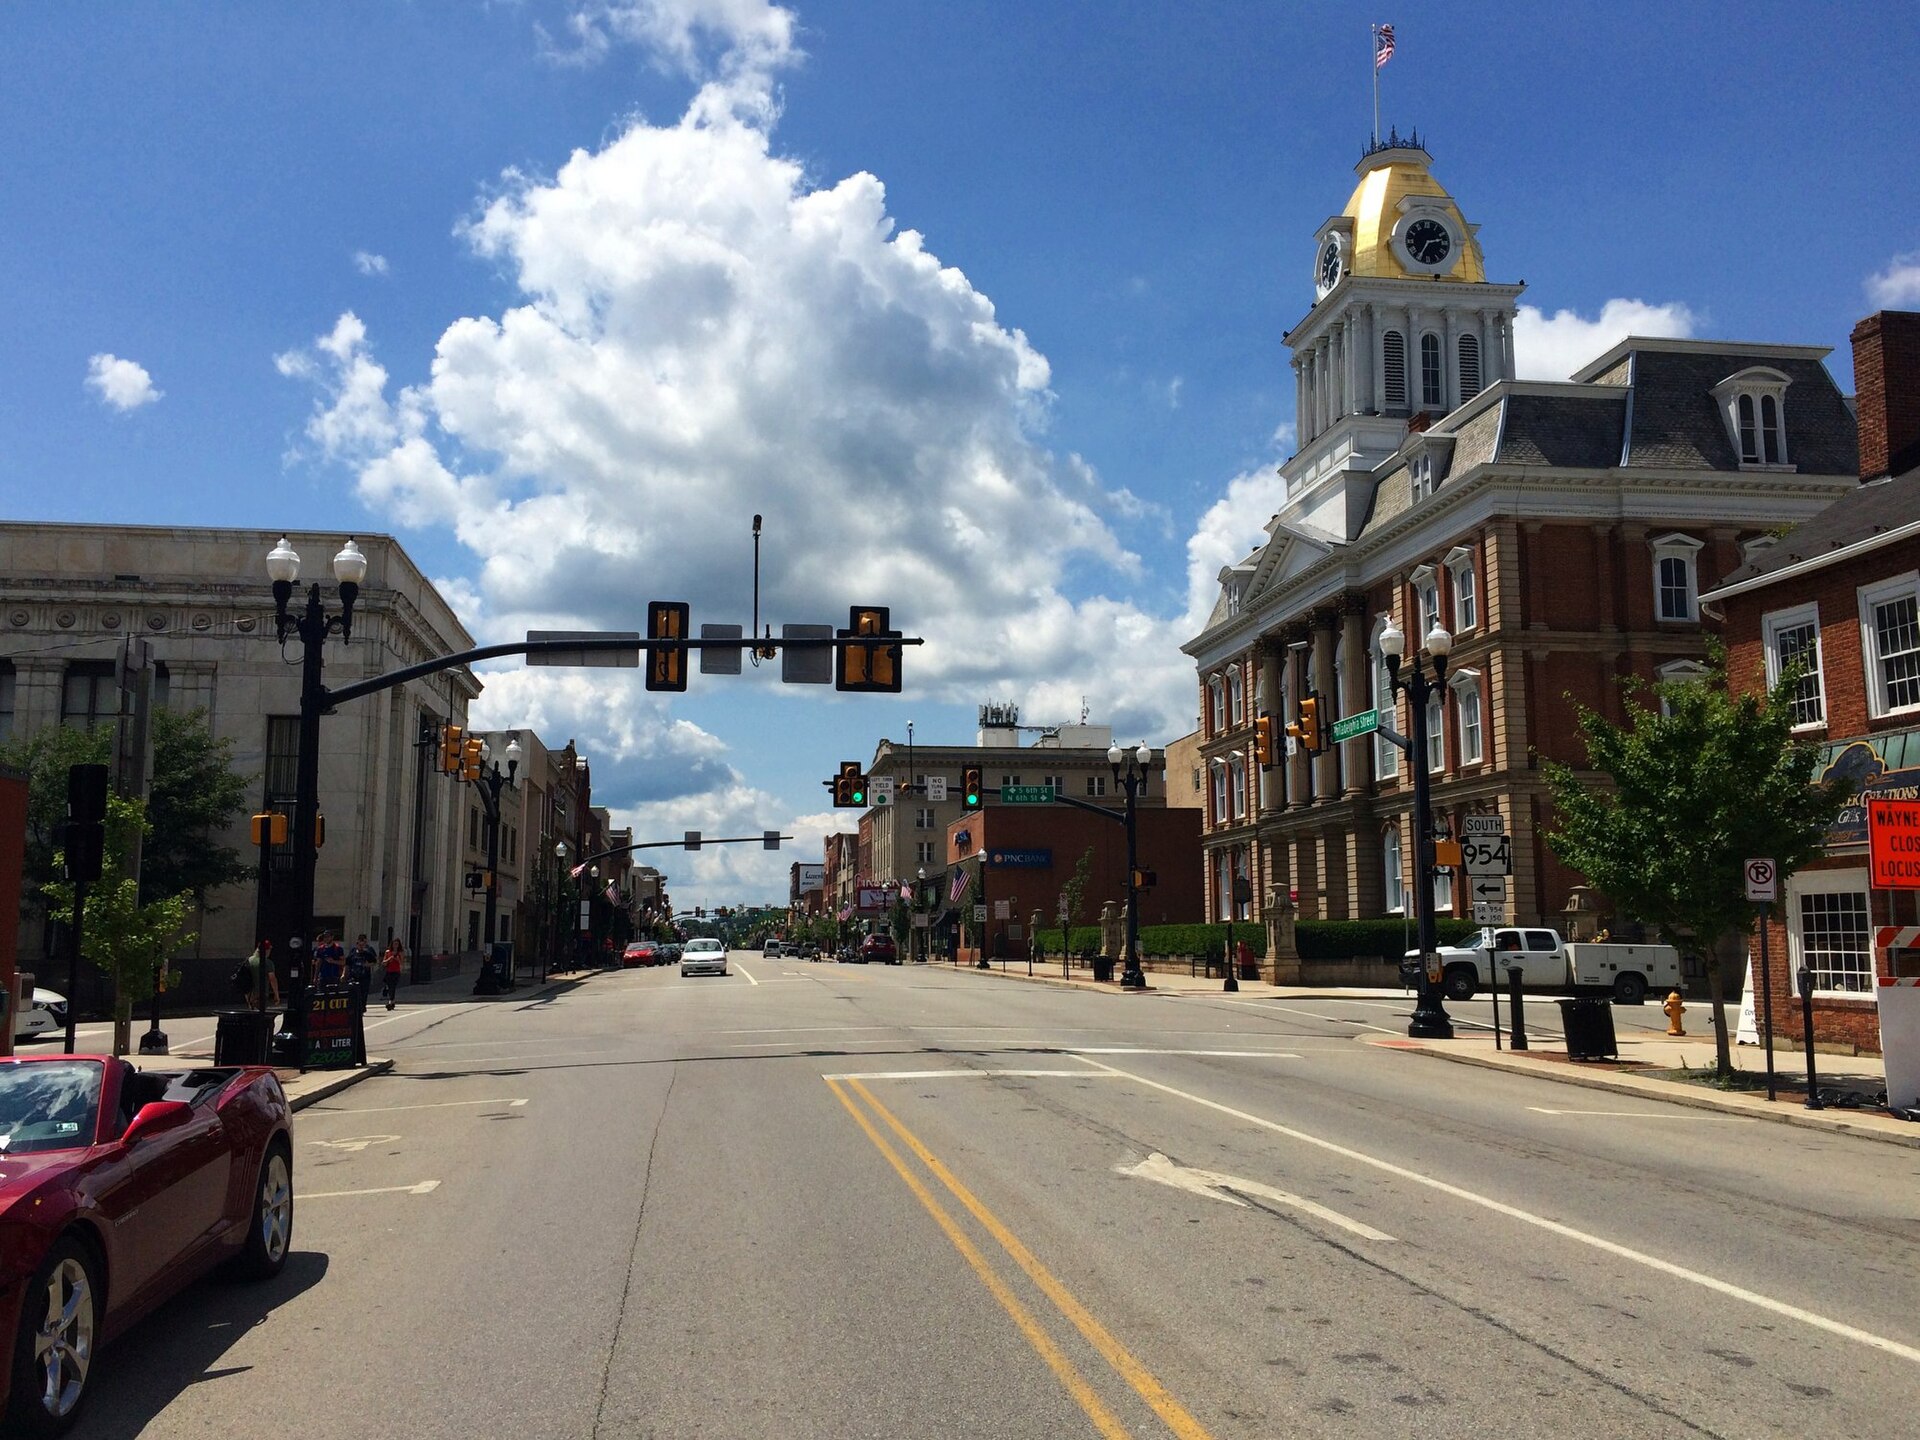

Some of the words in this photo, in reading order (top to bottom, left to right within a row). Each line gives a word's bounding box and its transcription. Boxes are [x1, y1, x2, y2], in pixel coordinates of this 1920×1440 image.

[1333, 717, 1360, 737] Philadelphia
[1360, 712, 1375, 729] Street
[1466, 819, 1503, 832] SOUTH
[1877, 810, 1919, 827] WAYNE
[1890, 835, 1920, 852] CLOS
[1463, 844, 1507, 865] 954
[1881, 860, 1920, 877] LOCUS
[975, 913, 986, 921] 25
[313, 1000, 325, 1010] 21
[328, 998, 348, 1009] CUT
[315, 1039, 321, 1049] A
[331, 1038, 352, 1048] LITER
